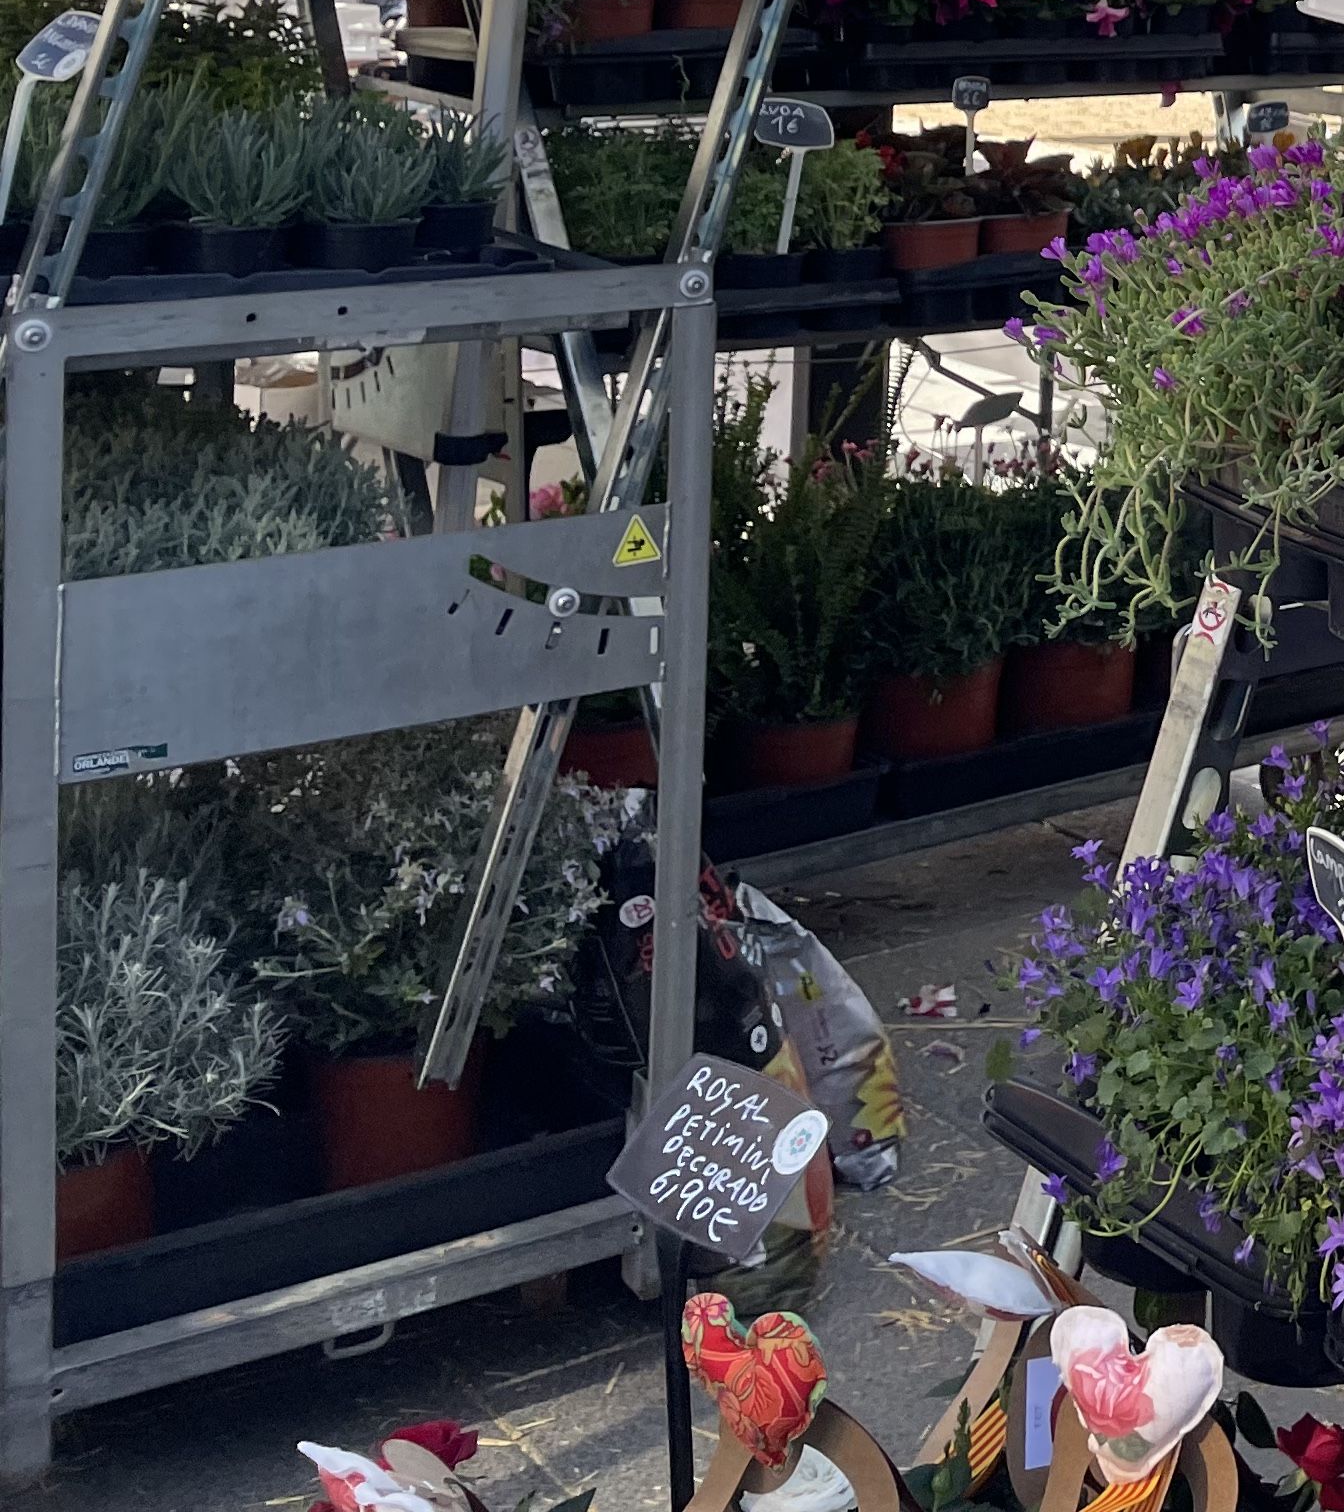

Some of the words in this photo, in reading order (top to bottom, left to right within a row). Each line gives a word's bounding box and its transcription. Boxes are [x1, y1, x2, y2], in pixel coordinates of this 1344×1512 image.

[686, 1066, 770, 1123] ROSAL
[649, 1168, 739, 1242] 6,90€
[662, 1135, 768, 1213] DECORADO
